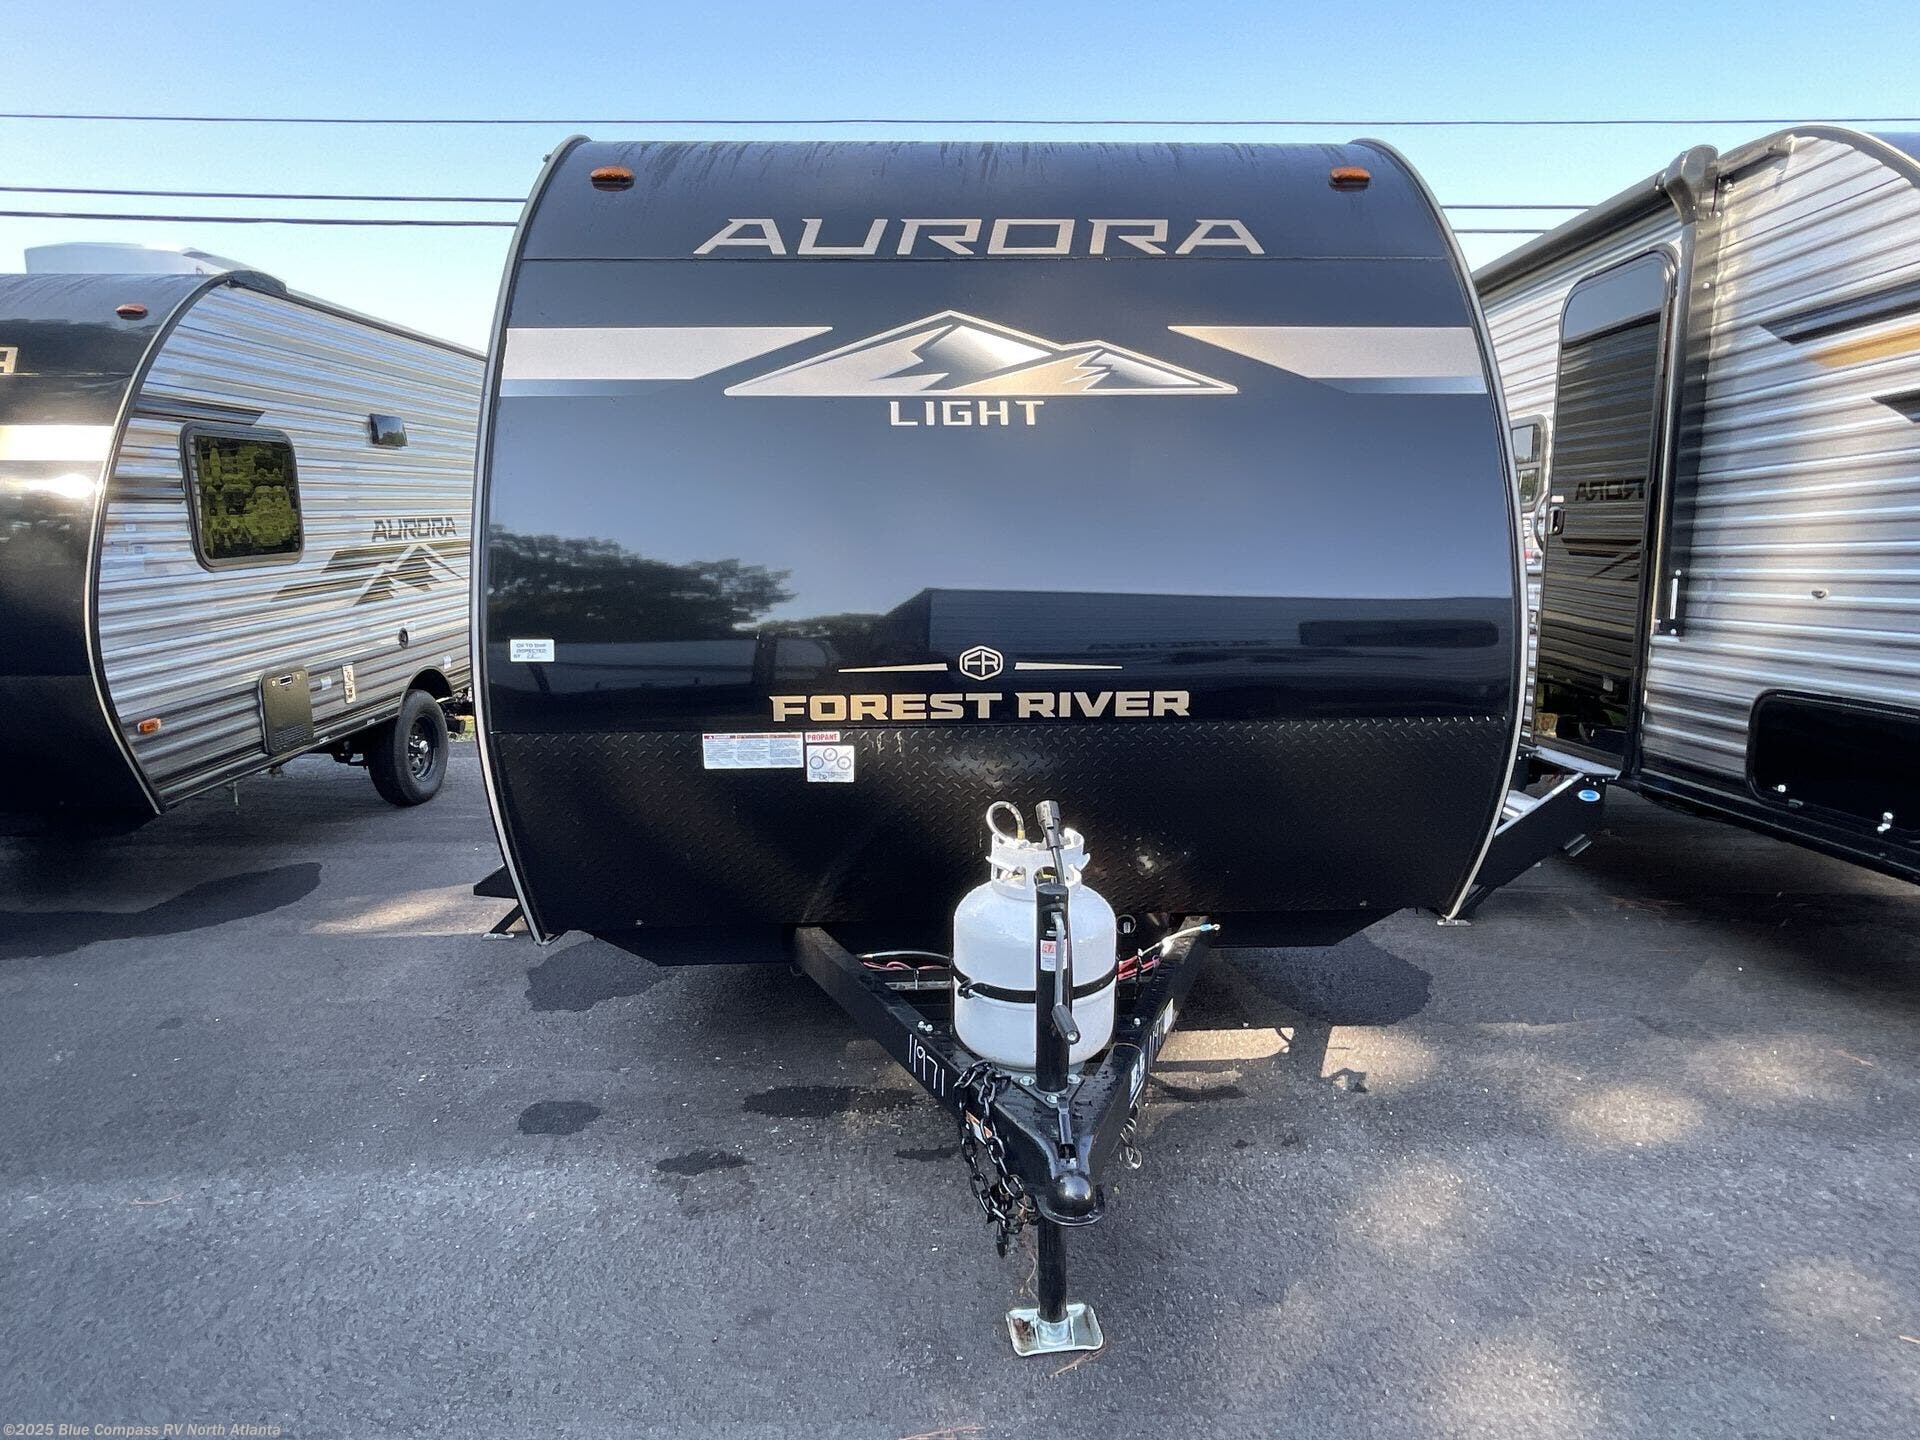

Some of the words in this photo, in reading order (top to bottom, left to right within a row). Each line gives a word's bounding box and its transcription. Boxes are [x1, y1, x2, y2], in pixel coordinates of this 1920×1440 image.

[693, 218, 1265, 255] AURORA
[889, 400, 1045, 427] LIGHT
[371, 516, 457, 542] AURORA
[769, 693, 1002, 722] FOREST
[1015, 690, 1190, 719] RIVER
[806, 733, 838, 742] PROPANE
[908, 1034, 945, 1097] 11971
